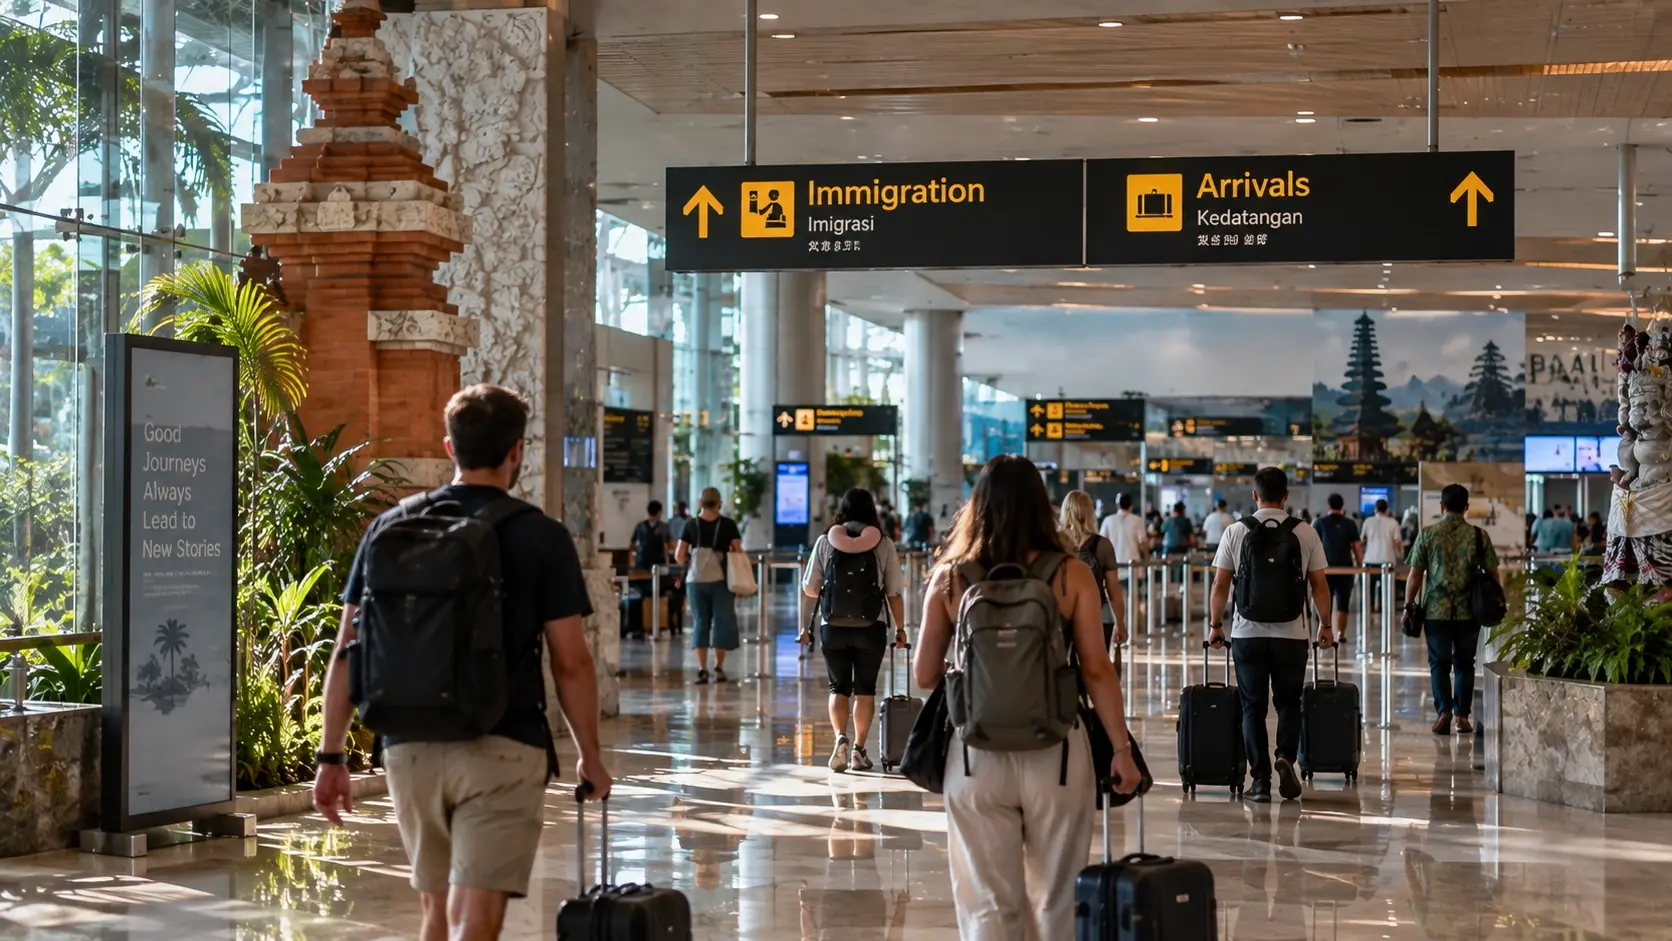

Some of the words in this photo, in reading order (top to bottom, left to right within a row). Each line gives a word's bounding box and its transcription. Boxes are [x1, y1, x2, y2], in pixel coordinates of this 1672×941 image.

[808, 177, 985, 211] Immigration
[1197, 170, 1311, 199] Arrivals
[808, 216, 875, 235] Imigrasi
[1198, 208, 1303, 229] Kedatangan
[144, 422, 182, 443] Good
[143, 452, 206, 477] Journeys
[143, 481, 192, 505] Always
[143, 511, 178, 530] Lead
[182, 512, 196, 530] to
[142, 539, 173, 559] New
[176, 538, 221, 558] Stories
